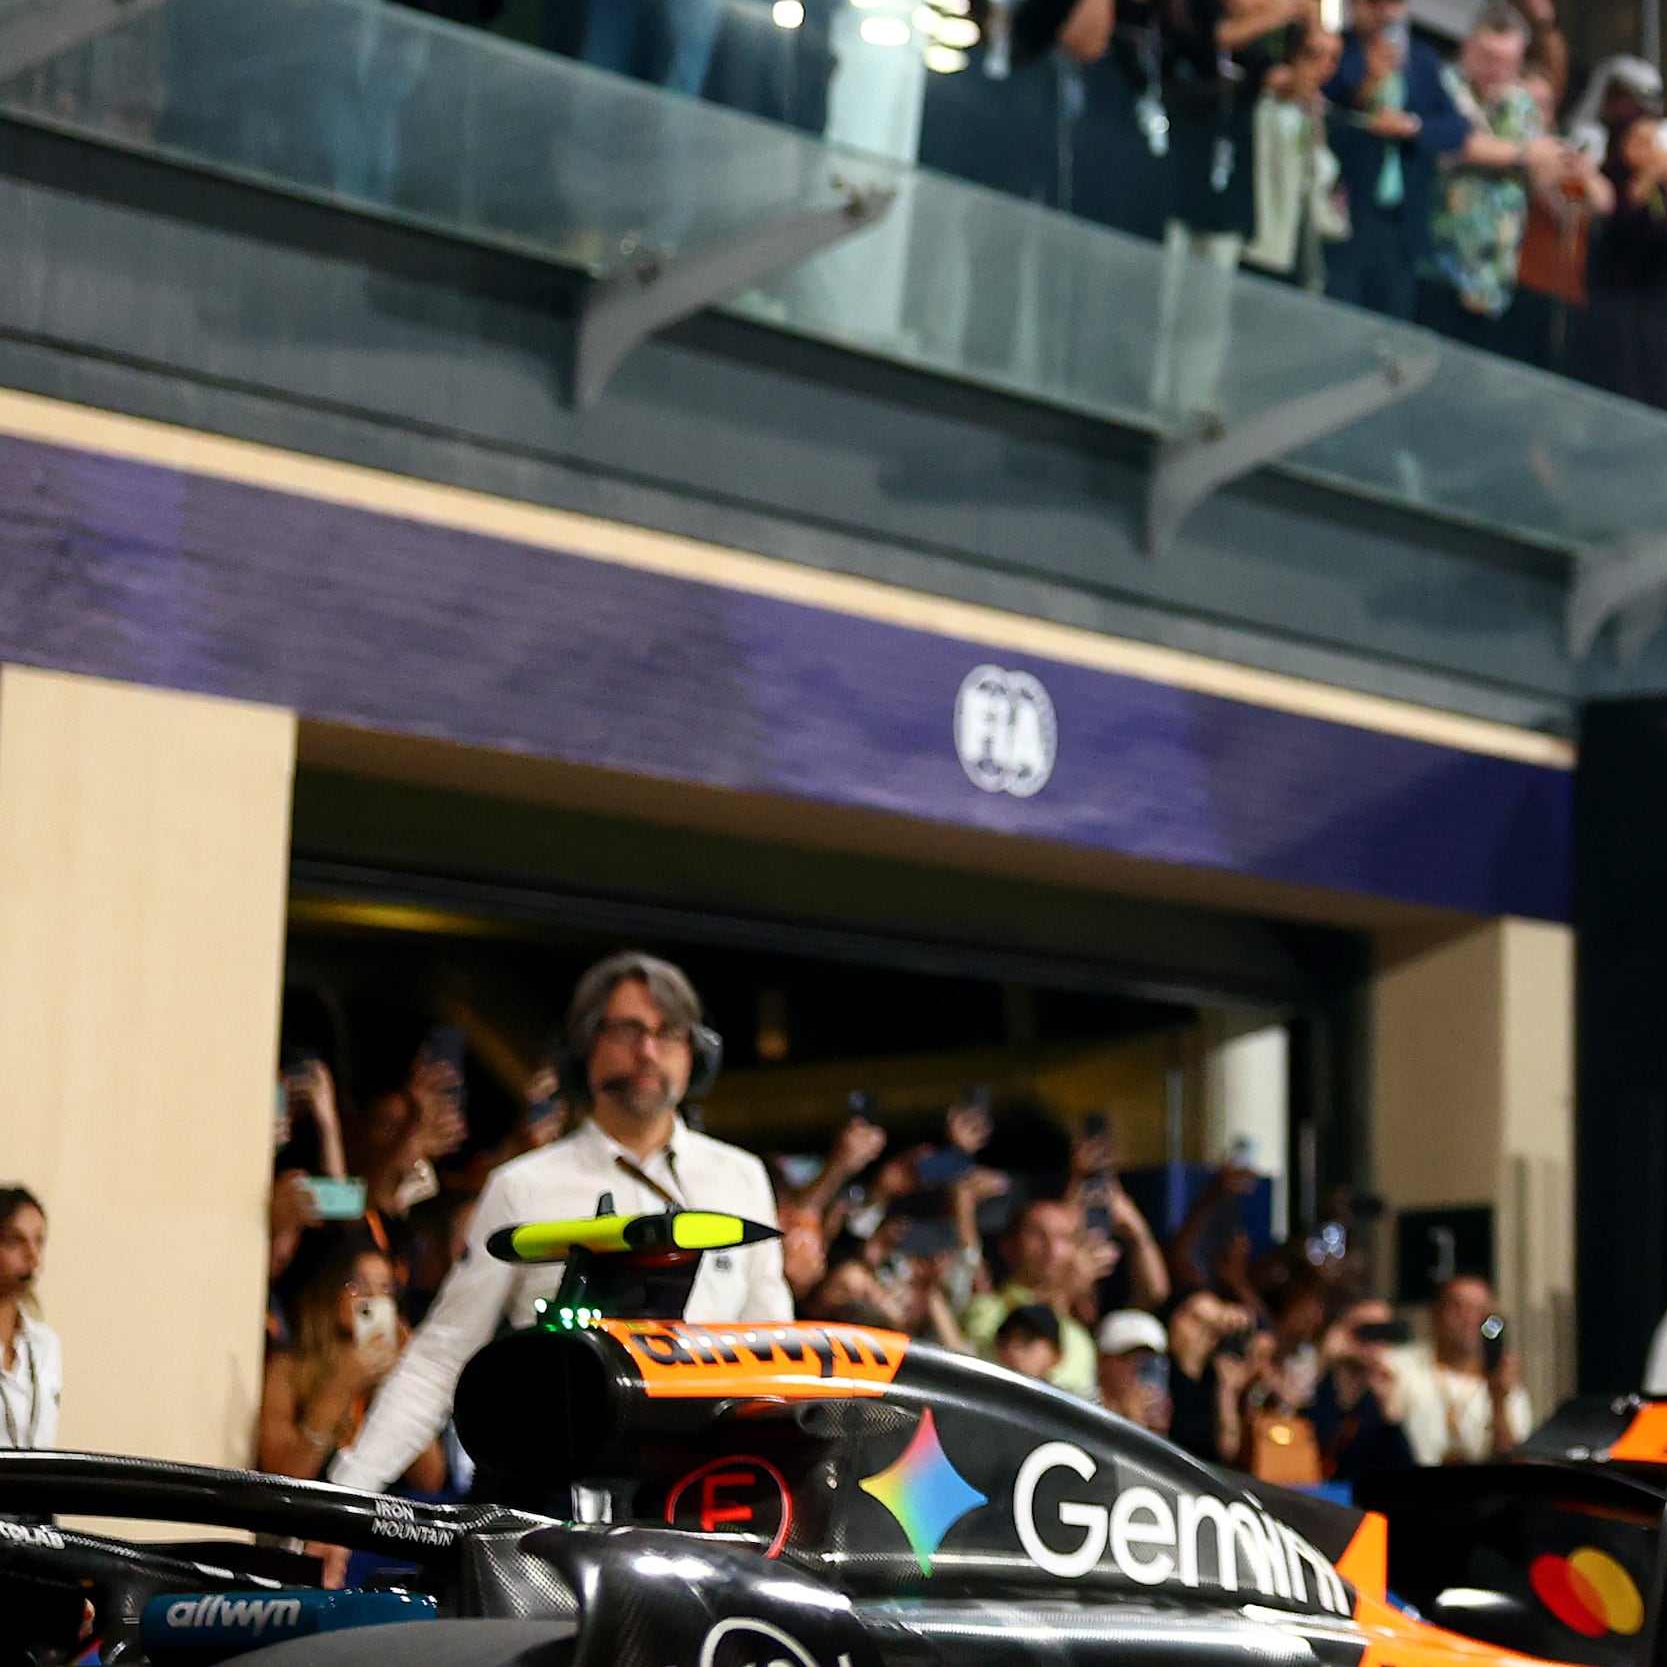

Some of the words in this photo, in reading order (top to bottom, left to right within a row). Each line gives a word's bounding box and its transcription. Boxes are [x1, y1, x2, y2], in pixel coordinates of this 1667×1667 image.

[375, 1499, 415, 1523] IRON
[371, 1517, 454, 1547] MOUNTAIN
[166, 1594, 302, 1634] allwyn
